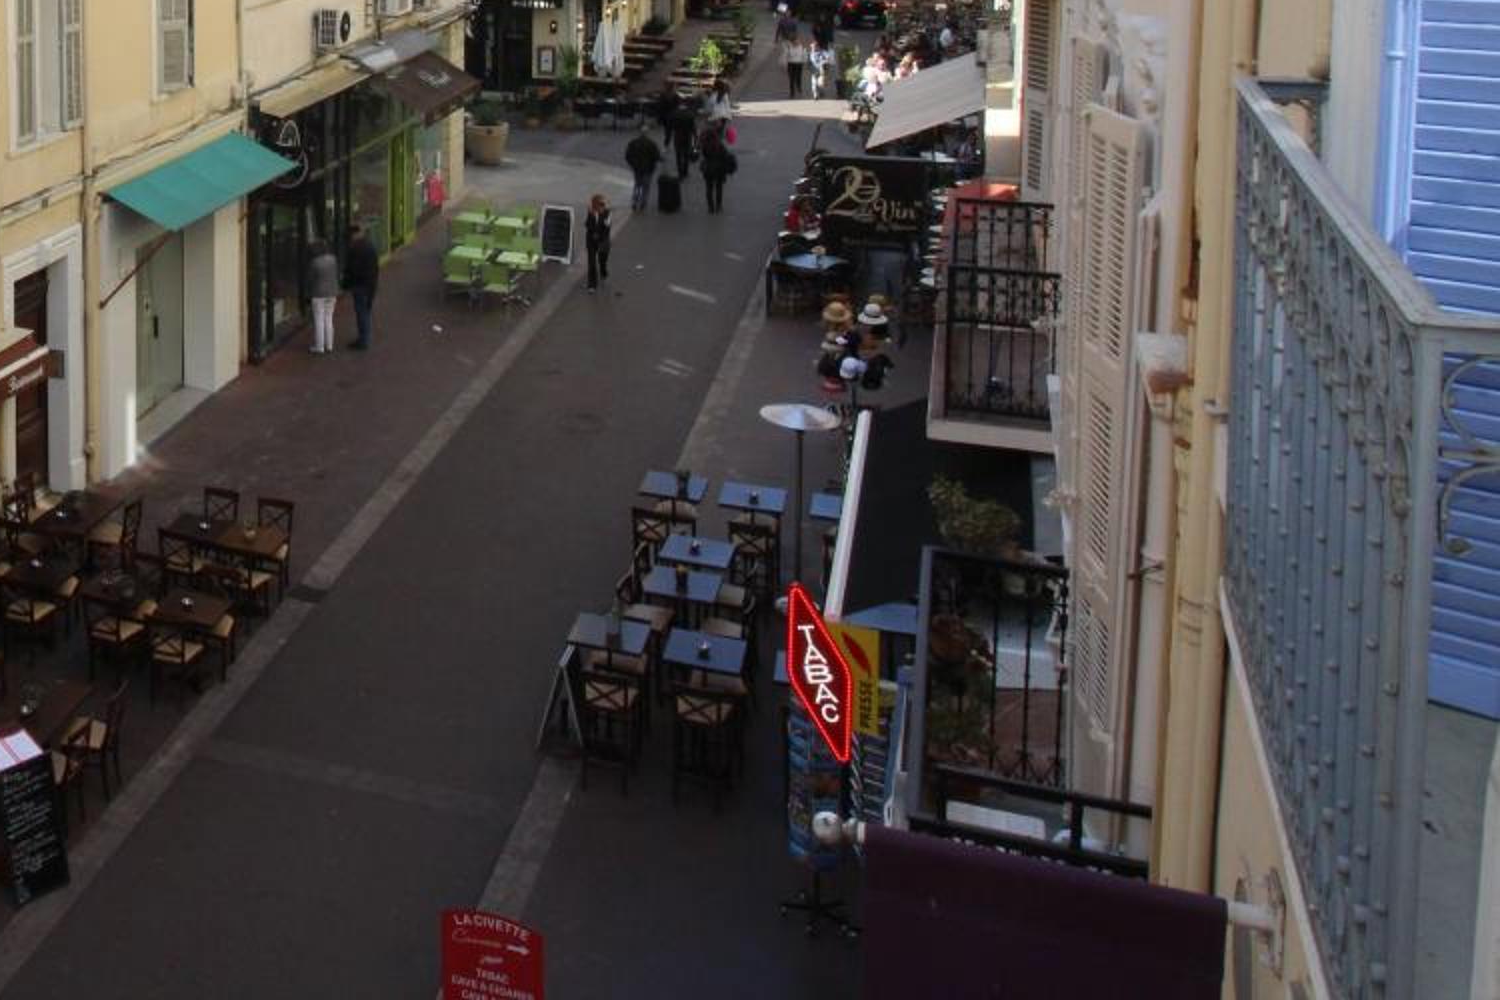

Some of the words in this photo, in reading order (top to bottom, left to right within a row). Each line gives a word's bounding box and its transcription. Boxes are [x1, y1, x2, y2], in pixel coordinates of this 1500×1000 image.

[797, 625, 840, 723] TABAC
[452, 913, 473, 926] LA
[473, 914, 532, 942] CIVETTE
